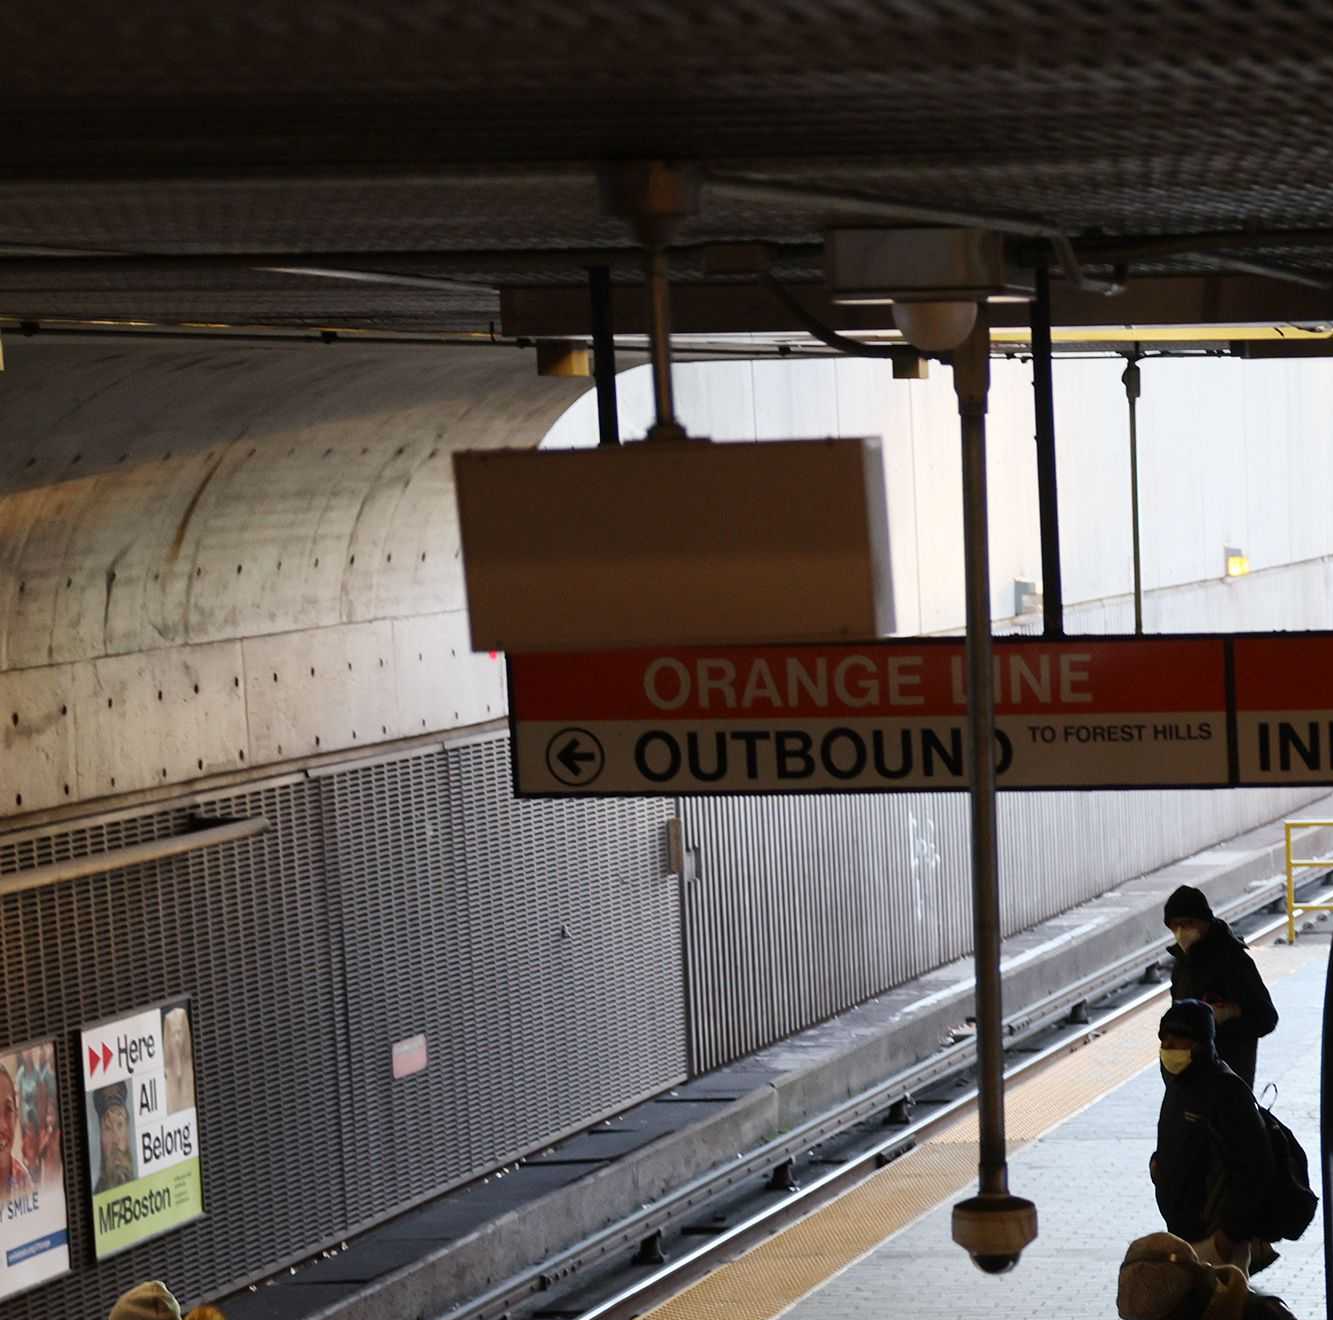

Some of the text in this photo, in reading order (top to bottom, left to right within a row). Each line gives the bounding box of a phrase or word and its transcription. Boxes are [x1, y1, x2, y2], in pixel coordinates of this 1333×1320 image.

[642, 651, 1094, 711] ORANGE LINE
[1028, 722, 1212, 743] TO FOREST HILLS
[117, 1033, 156, 1074] Here
[139, 1077, 158, 1116] All
[141, 1124, 193, 1164] Belong
[7, 1191, 39, 1220] SMILE
